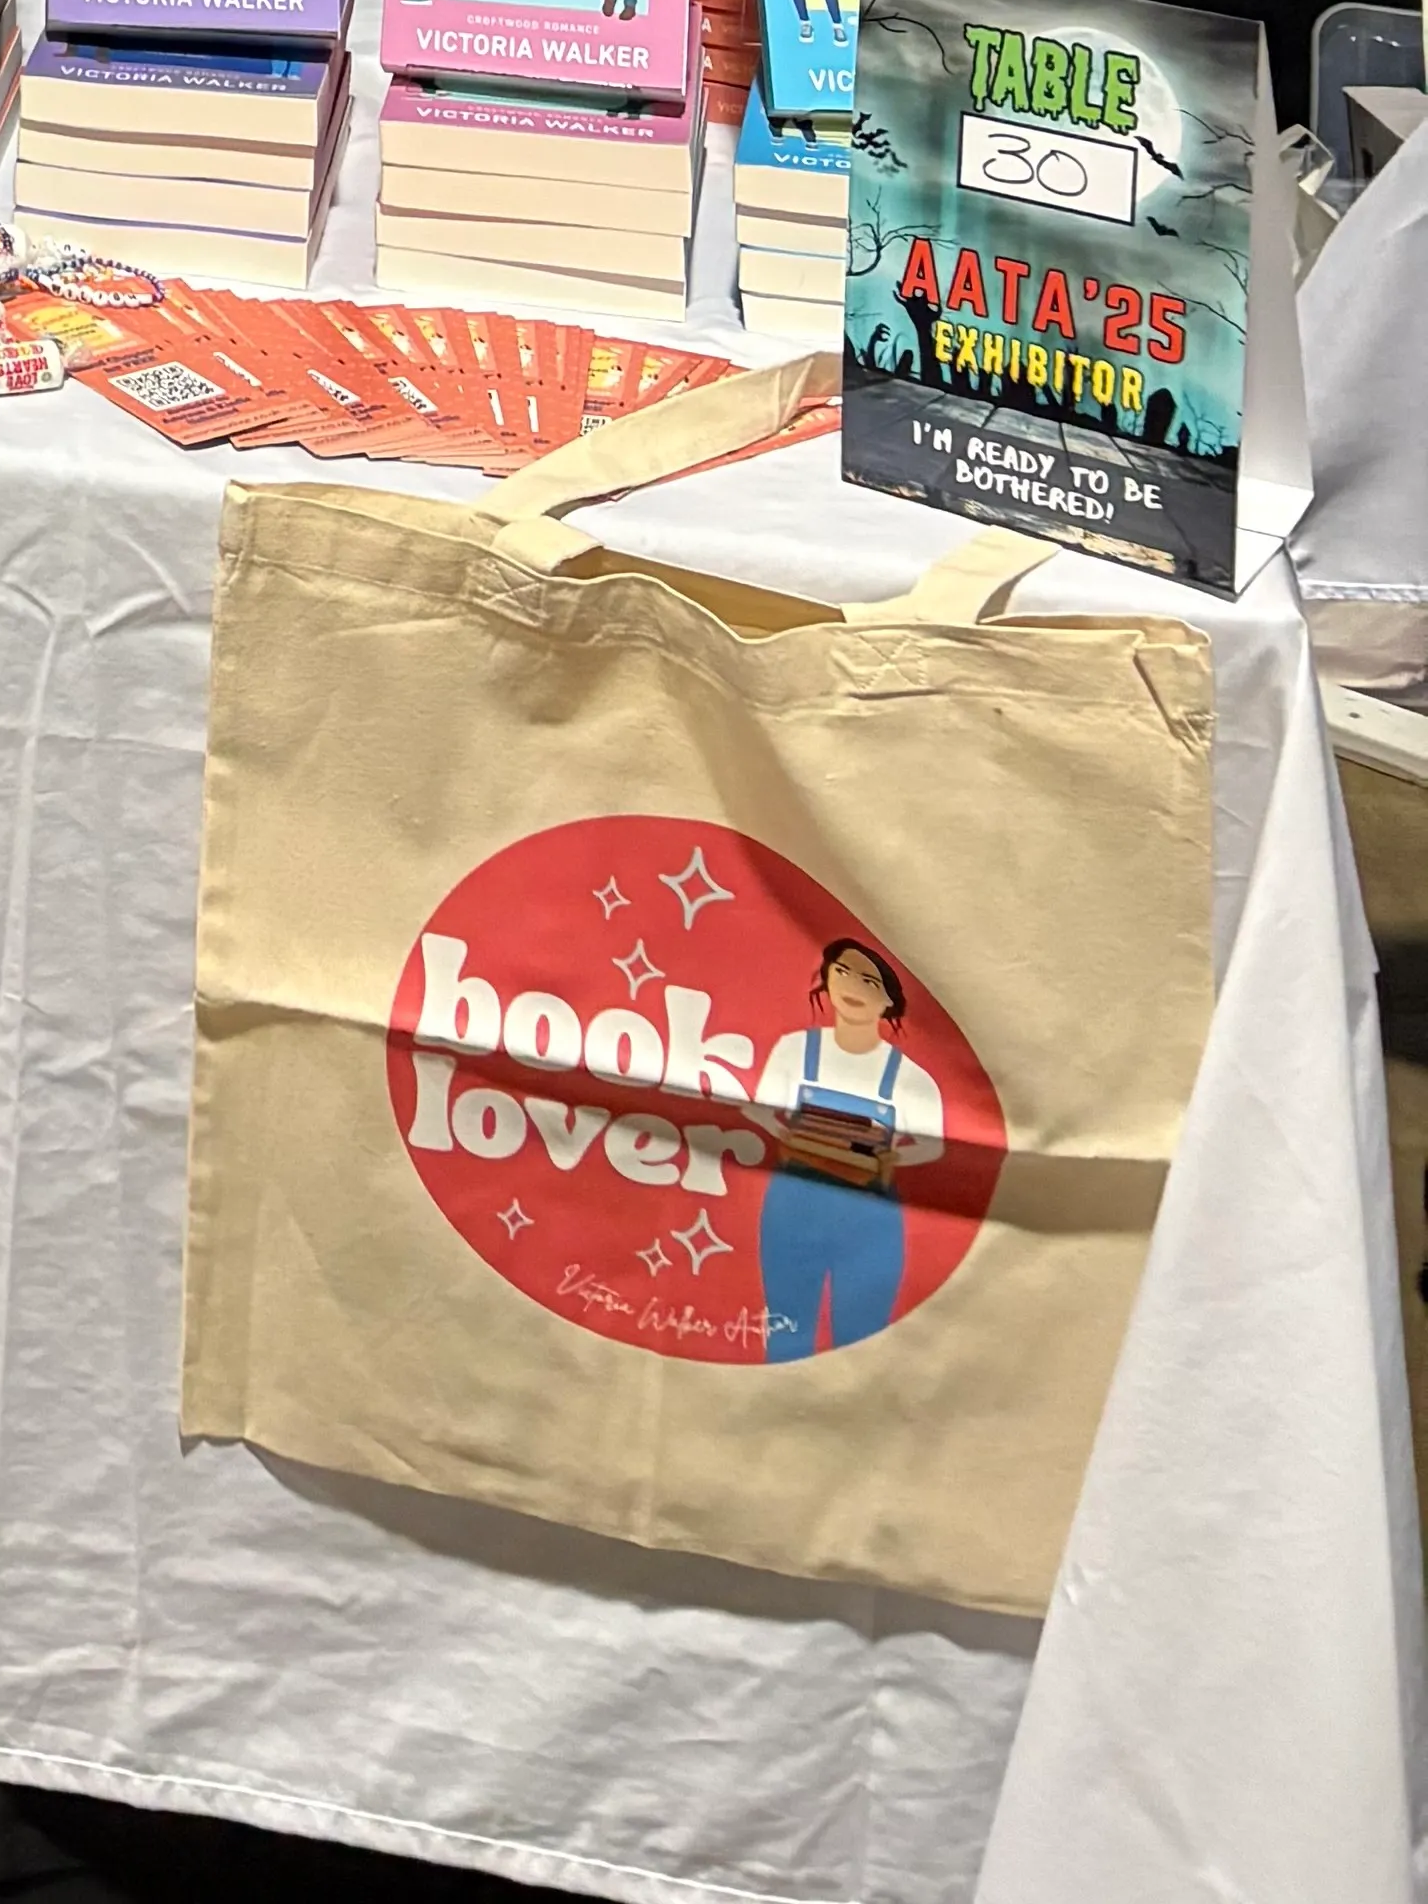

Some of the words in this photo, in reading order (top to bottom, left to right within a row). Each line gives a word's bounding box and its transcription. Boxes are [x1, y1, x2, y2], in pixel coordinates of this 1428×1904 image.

[415, 28, 532, 59] VICTORIA
[541, 38, 650, 70] WALKER
[963, 23, 1140, 137] TABLE
[982, 134, 1085, 195] 30
[901, 237, 1187, 363] AATA'25
[935, 320, 1143, 413] EXHIBITOR
[912, 419, 953, 450] I'M
[967, 434, 1054, 480] READY
[1073, 467, 1110, 492] TO
[1124, 480, 1164, 511] BE
[955, 459, 1116, 524] BOTHERED!
[414, 932, 755, 1102] book
[408, 1053, 765, 1196] lover
